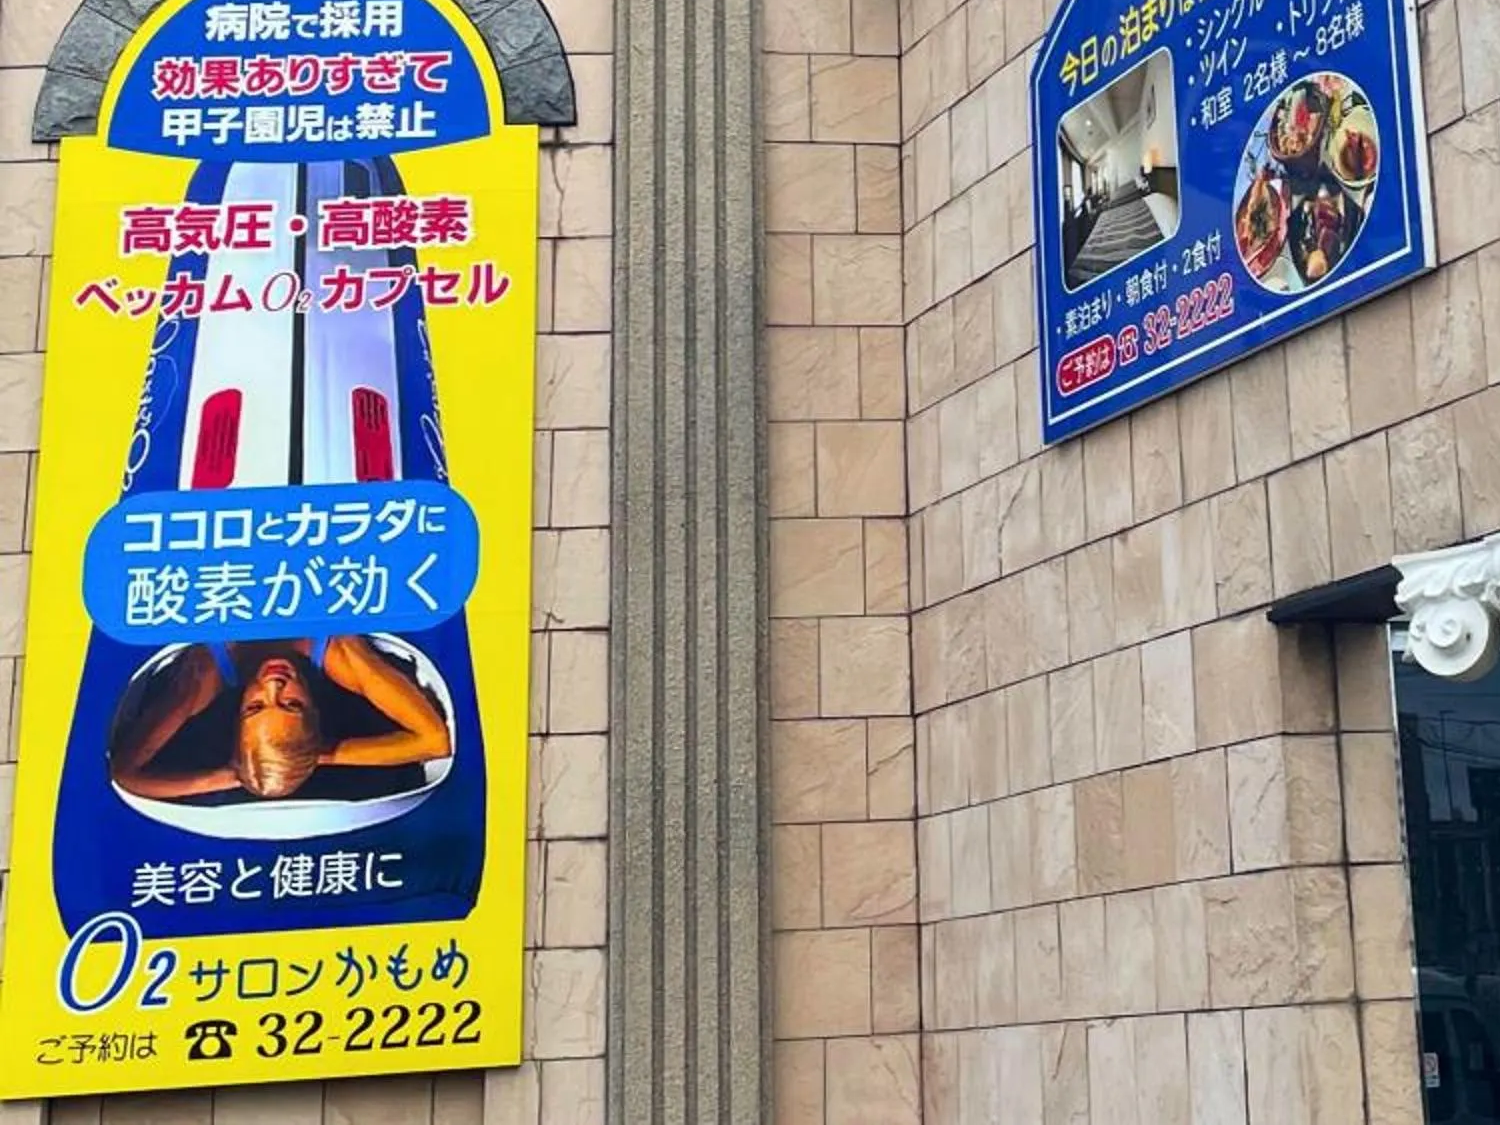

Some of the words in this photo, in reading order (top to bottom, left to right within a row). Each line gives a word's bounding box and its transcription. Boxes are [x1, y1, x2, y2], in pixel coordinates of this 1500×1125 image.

[204, 0, 404, 41] 病院で採用
[153, 52, 451, 99] 効果ありすぎて
[161, 102, 436, 146] 甲子園児は禁止
[120, 198, 469, 254] 高気圧・高酸素
[1143, 272, 1234, 355] 32-2222
[122, 499, 446, 553] ココロとカラダに
[126, 553, 441, 627] 酸素が効く
[131, 850, 403, 908] 美容と健康に
[37, 1032, 159, 1065] ご予約は
[256, 1000, 481, 1058] 32-2222
